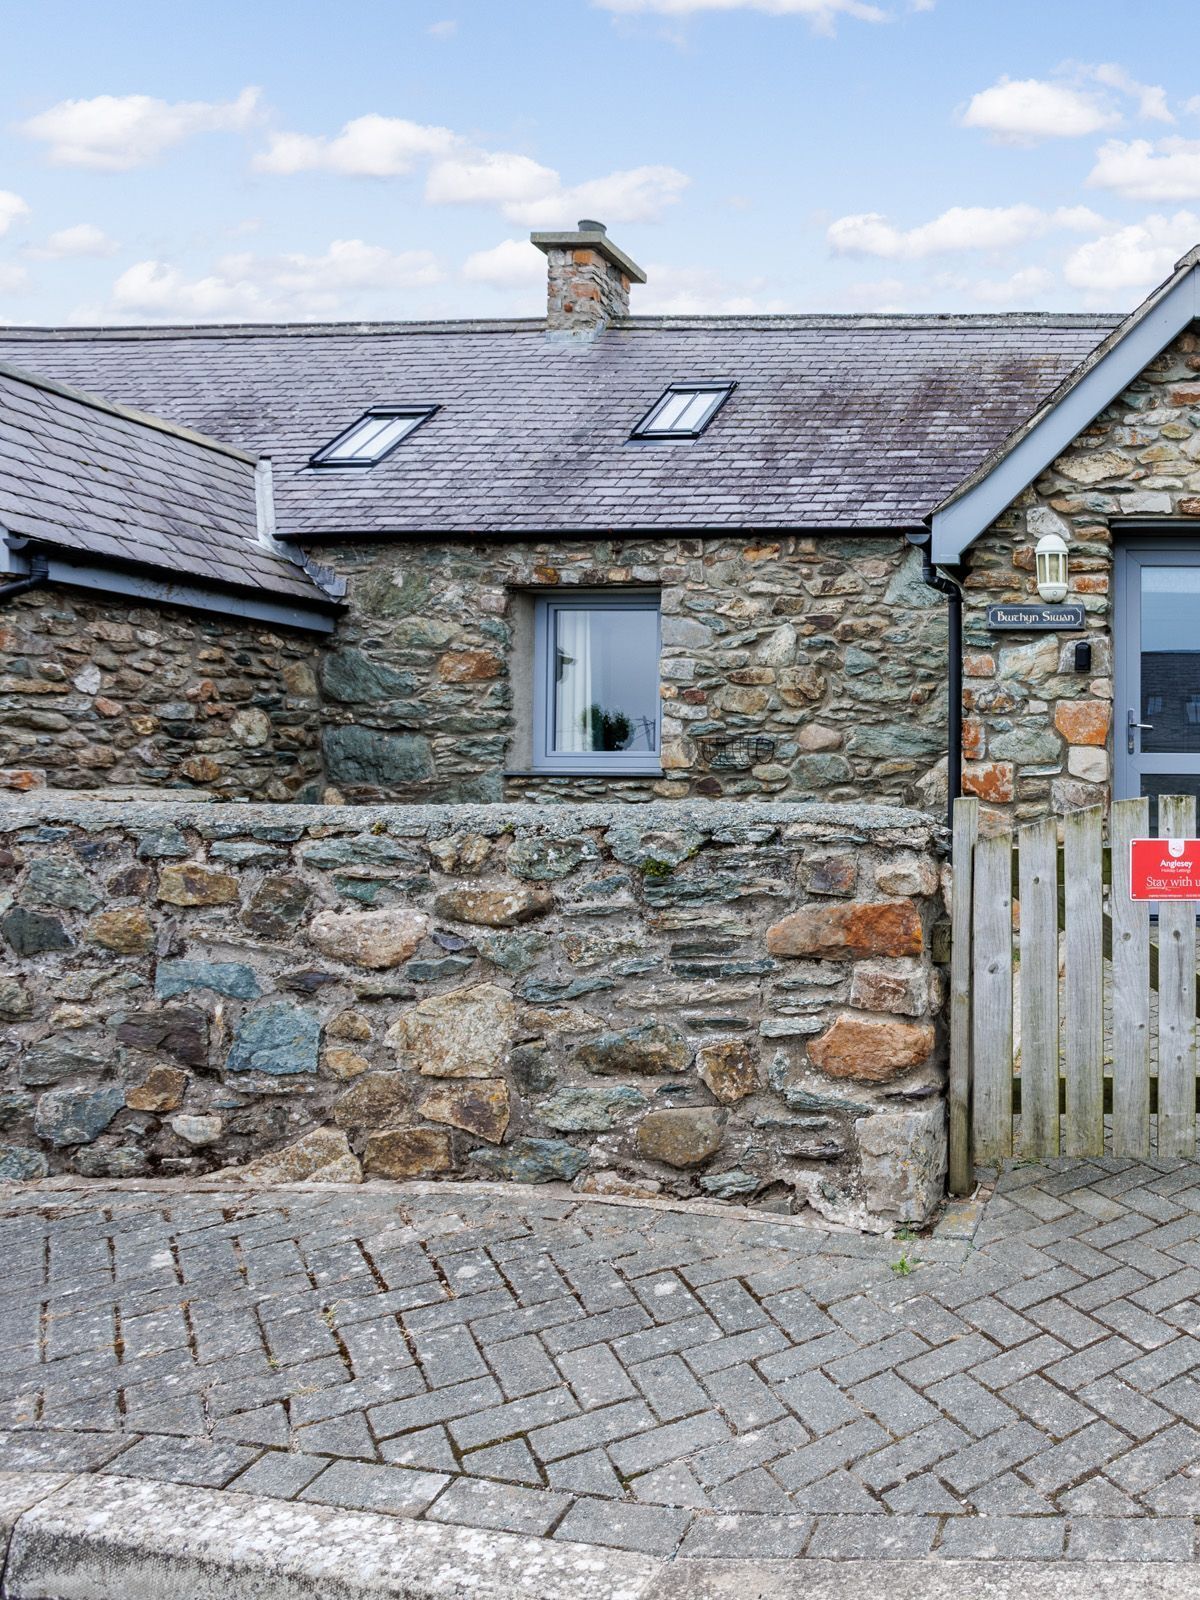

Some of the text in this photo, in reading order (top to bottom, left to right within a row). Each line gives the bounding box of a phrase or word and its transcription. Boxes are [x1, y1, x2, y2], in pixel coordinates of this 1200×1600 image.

[997, 610, 1075, 624] Bwthyn Siwan
[1160, 860, 1192, 869] Anglesey
[1146, 876, 1168, 889] Stay
[1169, 876, 1192, 887] with
